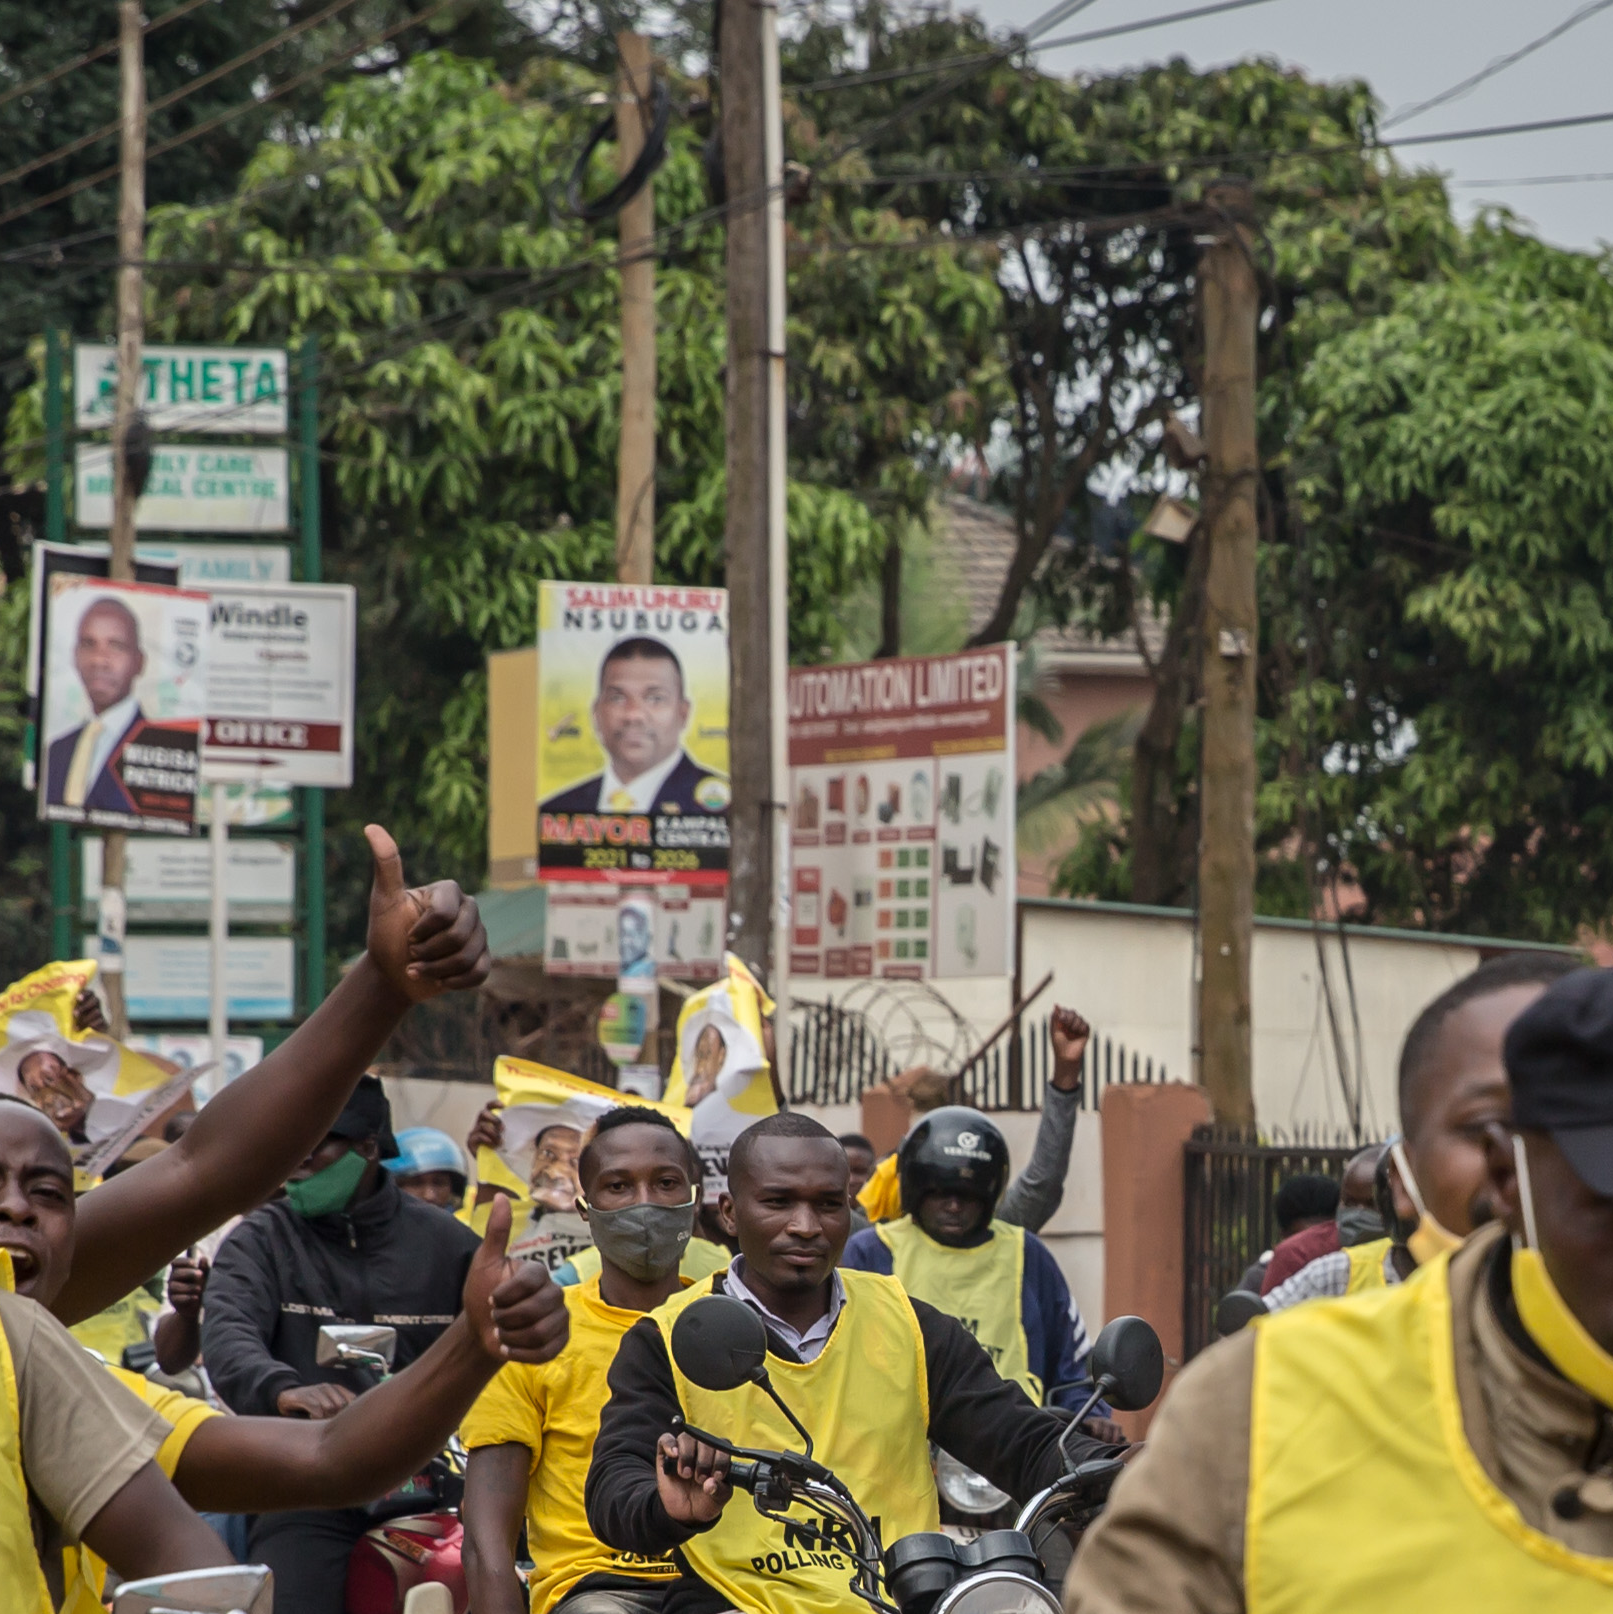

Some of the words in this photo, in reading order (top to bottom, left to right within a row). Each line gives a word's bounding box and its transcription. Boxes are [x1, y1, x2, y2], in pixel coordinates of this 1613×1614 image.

[141, 359, 278, 403] THETA
[566, 586, 636, 610] SALIM
[209, 602, 309, 630] Windle
[563, 610, 724, 634] NSUBUGA
[915, 653, 1004, 708] LIMITED
[540, 814, 652, 846] MAYOR
[750, 1550, 846, 1575] POLLING
